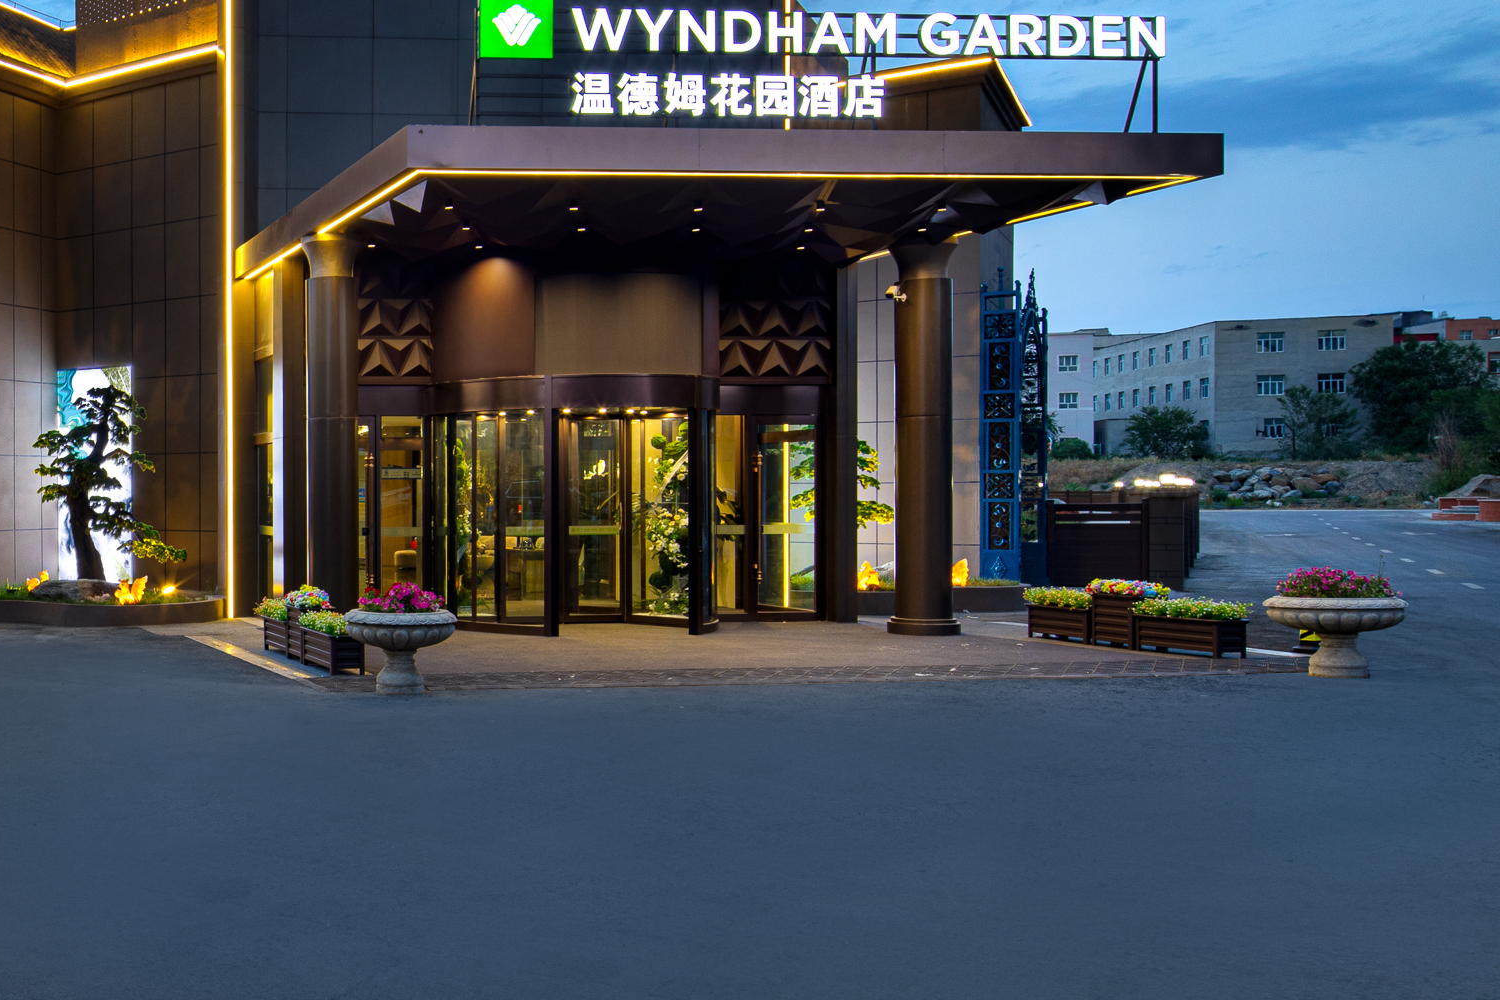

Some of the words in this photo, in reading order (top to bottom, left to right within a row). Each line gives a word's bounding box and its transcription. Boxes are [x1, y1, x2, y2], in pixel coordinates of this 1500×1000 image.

[571, 7, 897, 54] WYNDHAM
[919, 12, 1167, 58] GARDEN
[570, 71, 886, 118] 温德姆花园酒店
